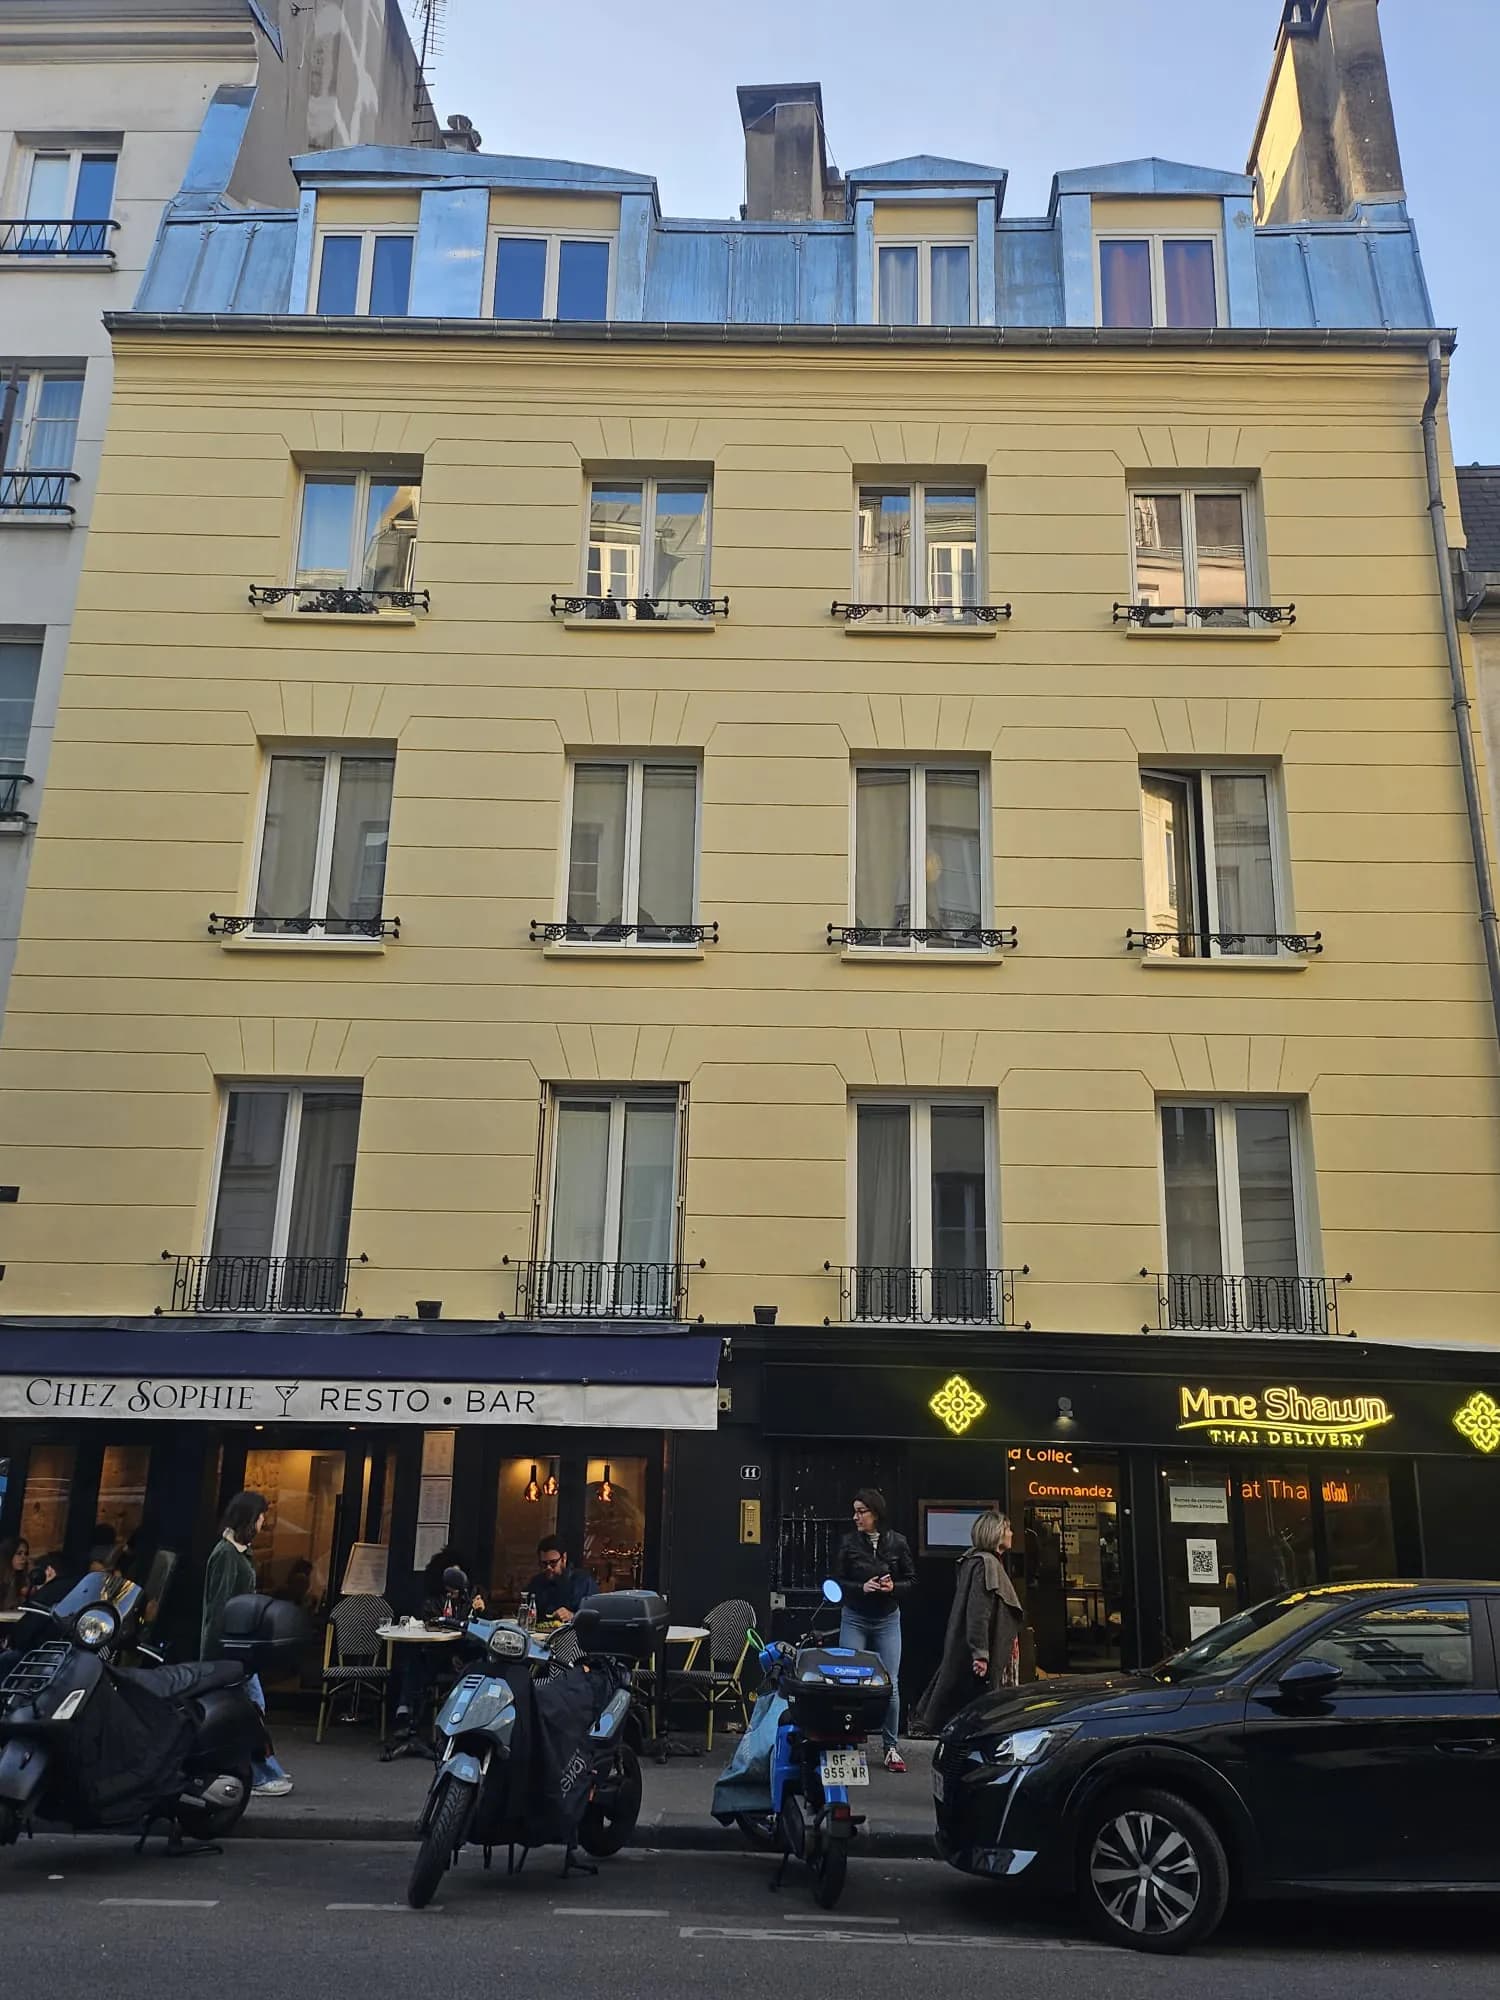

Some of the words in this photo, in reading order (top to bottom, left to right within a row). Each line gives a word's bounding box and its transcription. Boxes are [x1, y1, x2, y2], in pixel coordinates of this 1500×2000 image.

[320, 1387, 430, 1412] RESTO
[466, 1389, 536, 1413] BAR
[1181, 1386, 1258, 1420] Mme
[1263, 1386, 1387, 1423] Shawn
[1209, 1429, 1259, 1444] THAI
[1268, 1430, 1365, 1447] DELIVERY
[1026, 1448, 1073, 1464] Collec
[744, 1467, 757, 1478] 11
[1028, 1481, 1113, 1498] Commandez
[1267, 1479, 1309, 1500] Tha
